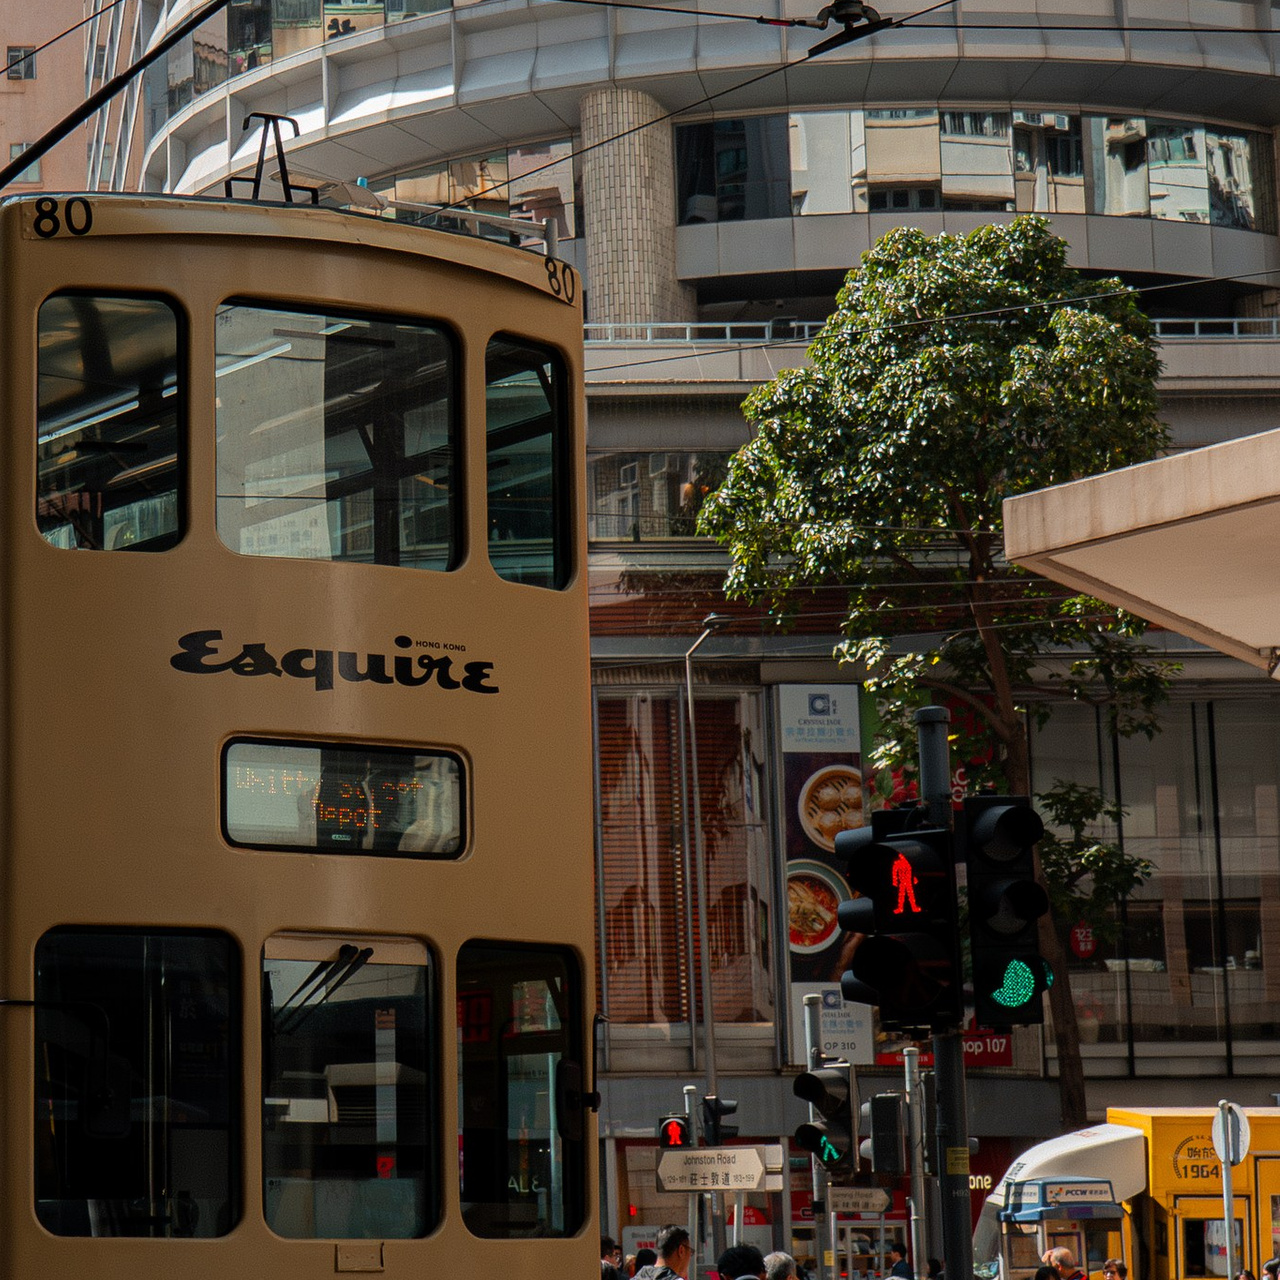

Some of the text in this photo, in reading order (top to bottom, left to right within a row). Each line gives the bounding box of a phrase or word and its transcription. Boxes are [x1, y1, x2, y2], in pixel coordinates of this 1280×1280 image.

[33, 196, 93, 238] 80
[545, 257, 577, 305] 80
[415, 640, 466, 652] HONG KONG
[170, 629, 500, 694] Esquire
[840, 1041, 856, 1052] 310
[985, 1037, 1007, 1054] 107
[684, 1153, 736, 1166] Johnston Road
[690, 1171, 730, 1186] 莊士敦道
[1182, 1164, 1220, 1179] 1964
[1065, 1188, 1088, 1196] PCCW
